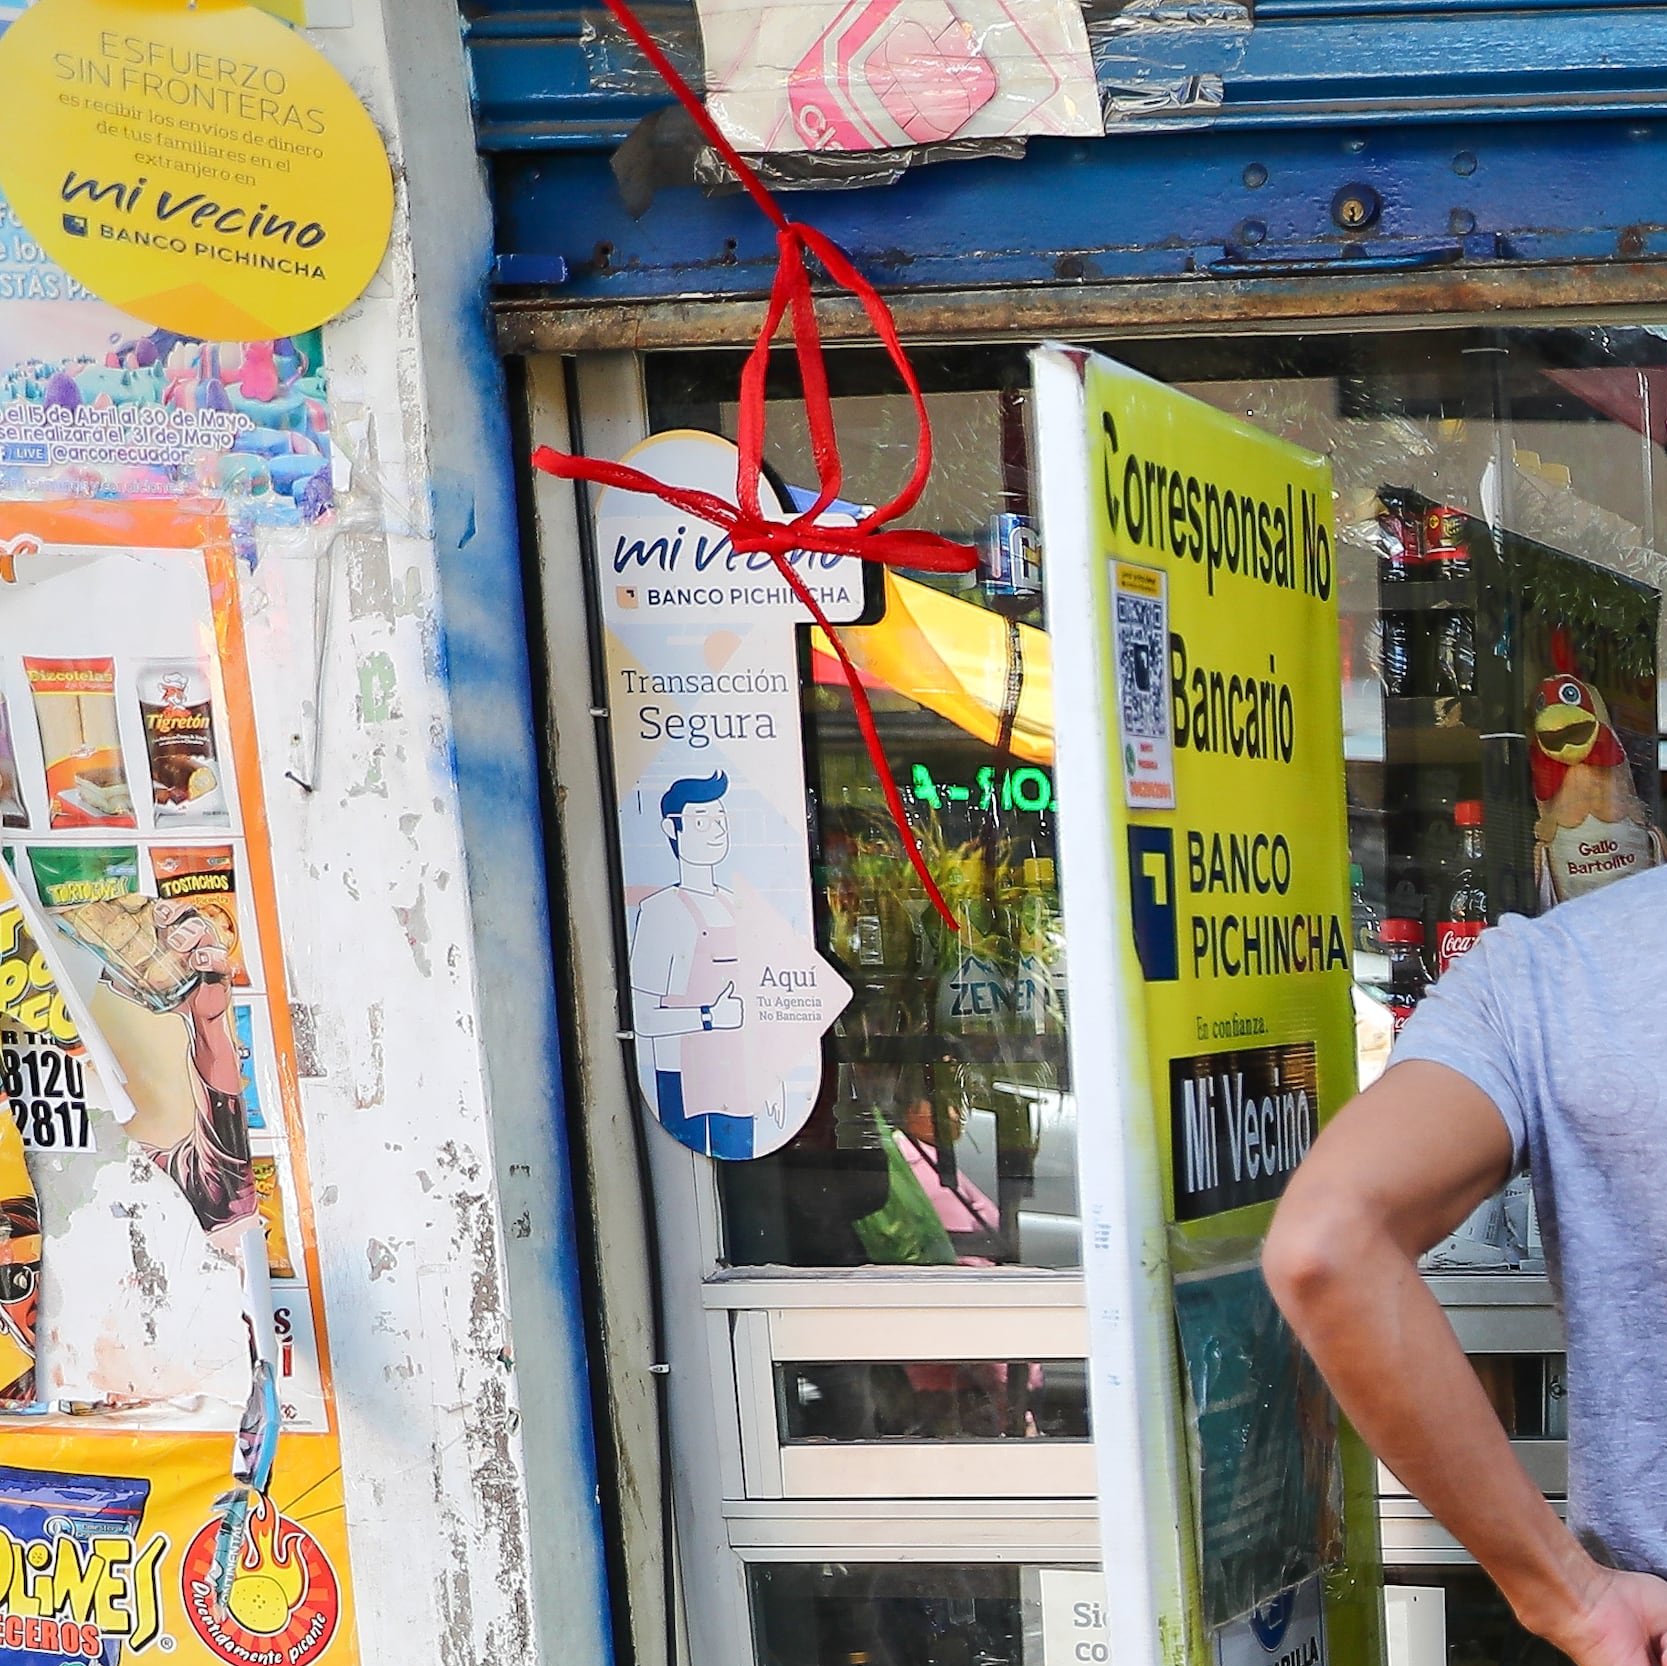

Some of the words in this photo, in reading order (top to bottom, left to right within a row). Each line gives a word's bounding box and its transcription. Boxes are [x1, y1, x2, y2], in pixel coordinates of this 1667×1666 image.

[100, 31, 287, 96] ESFUERZO
[53, 53, 111, 88] SIN
[122, 67, 326, 136] FRONTERAS
[58, 92, 80, 106] es
[85, 96, 143, 120] recibir
[149, 109, 174, 127] los
[242, 129, 264, 147] de
[267, 135, 324, 160] dinero
[96, 120, 119, 136] de
[123, 124, 152, 145] tus
[156, 131, 247, 163] familiares
[250, 154, 273, 170] en
[276, 157, 291, 174] el
[134, 151, 231, 182] extranjero
[235, 171, 256, 186] en
[61, 170, 148, 214] mi
[100, 223, 187, 254] BANCO
[195, 242, 327, 280] PICHINCHA
[77, 406, 117, 426] Abril
[142, 409, 166, 426] 30
[172, 409, 194, 426] de
[16, 448, 44, 460] LIVE
[1102, 410, 1298, 598] Corresponsal
[1300, 487, 1333, 603] No
[612, 525, 684, 573] mi
[648, 588, 724, 606] BANCO
[621, 668, 789, 695] Transacción
[1168, 631, 1295, 766] Bancario
[147, 713, 210, 731] Tigretón
[639, 706, 777, 748] Segura
[1186, 830, 1291, 897] BANCO
[1568, 853, 1636, 876] Bartolito
[1578, 839, 1619, 857] Gallo
[162, 875, 229, 896] TOSTACHOS
[1191, 914, 1350, 980] PICHINCHA
[760, 964, 817, 994] Aquí
[756, 996, 771, 1008] Tu
[775, 995, 823, 1010] Agencia
[759, 1011, 774, 1021] No
[778, 1009, 822, 1021] Bancaria
[1182, 1078, 1216, 1195] Mi
[1223, 1067, 1312, 1183] Vecino
[189, 1579, 283, 1666] Divertidamente
[288, 1613, 328, 1666] picante
